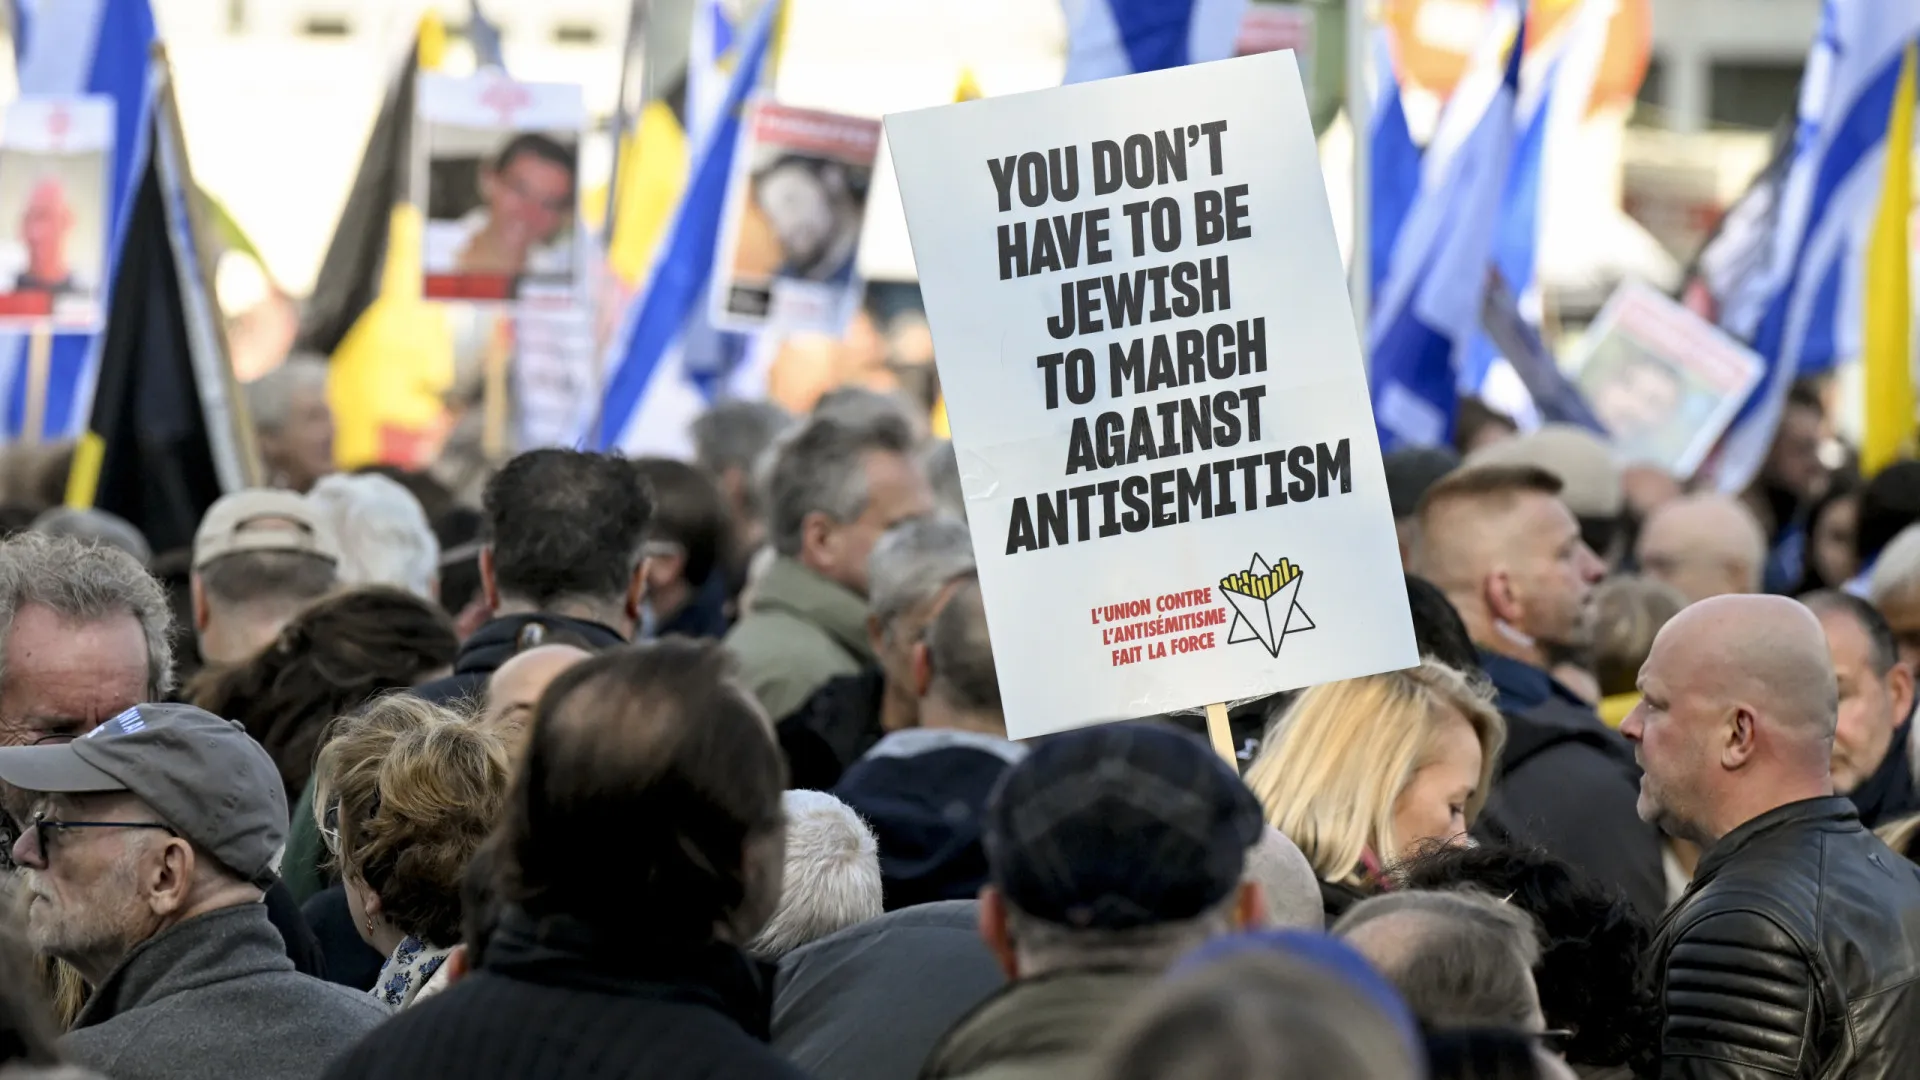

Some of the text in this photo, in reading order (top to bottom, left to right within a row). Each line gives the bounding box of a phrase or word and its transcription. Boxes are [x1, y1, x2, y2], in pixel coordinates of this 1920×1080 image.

[987, 120, 1227, 212] YOU DON’T
[998, 184, 1251, 280] HAVE TO BE
[1047, 256, 1230, 339] JEWISH
[1037, 317, 1267, 409] TO MARCH
[1066, 385, 1266, 475] AGAINST
[1006, 439, 1351, 555] ANTISEMITISM
[1091, 587, 1212, 625] L’UNION CONTRE
[1103, 608, 1227, 645] L’ANTISÉMITISME
[1112, 631, 1216, 667] FAIT LA FORCE
